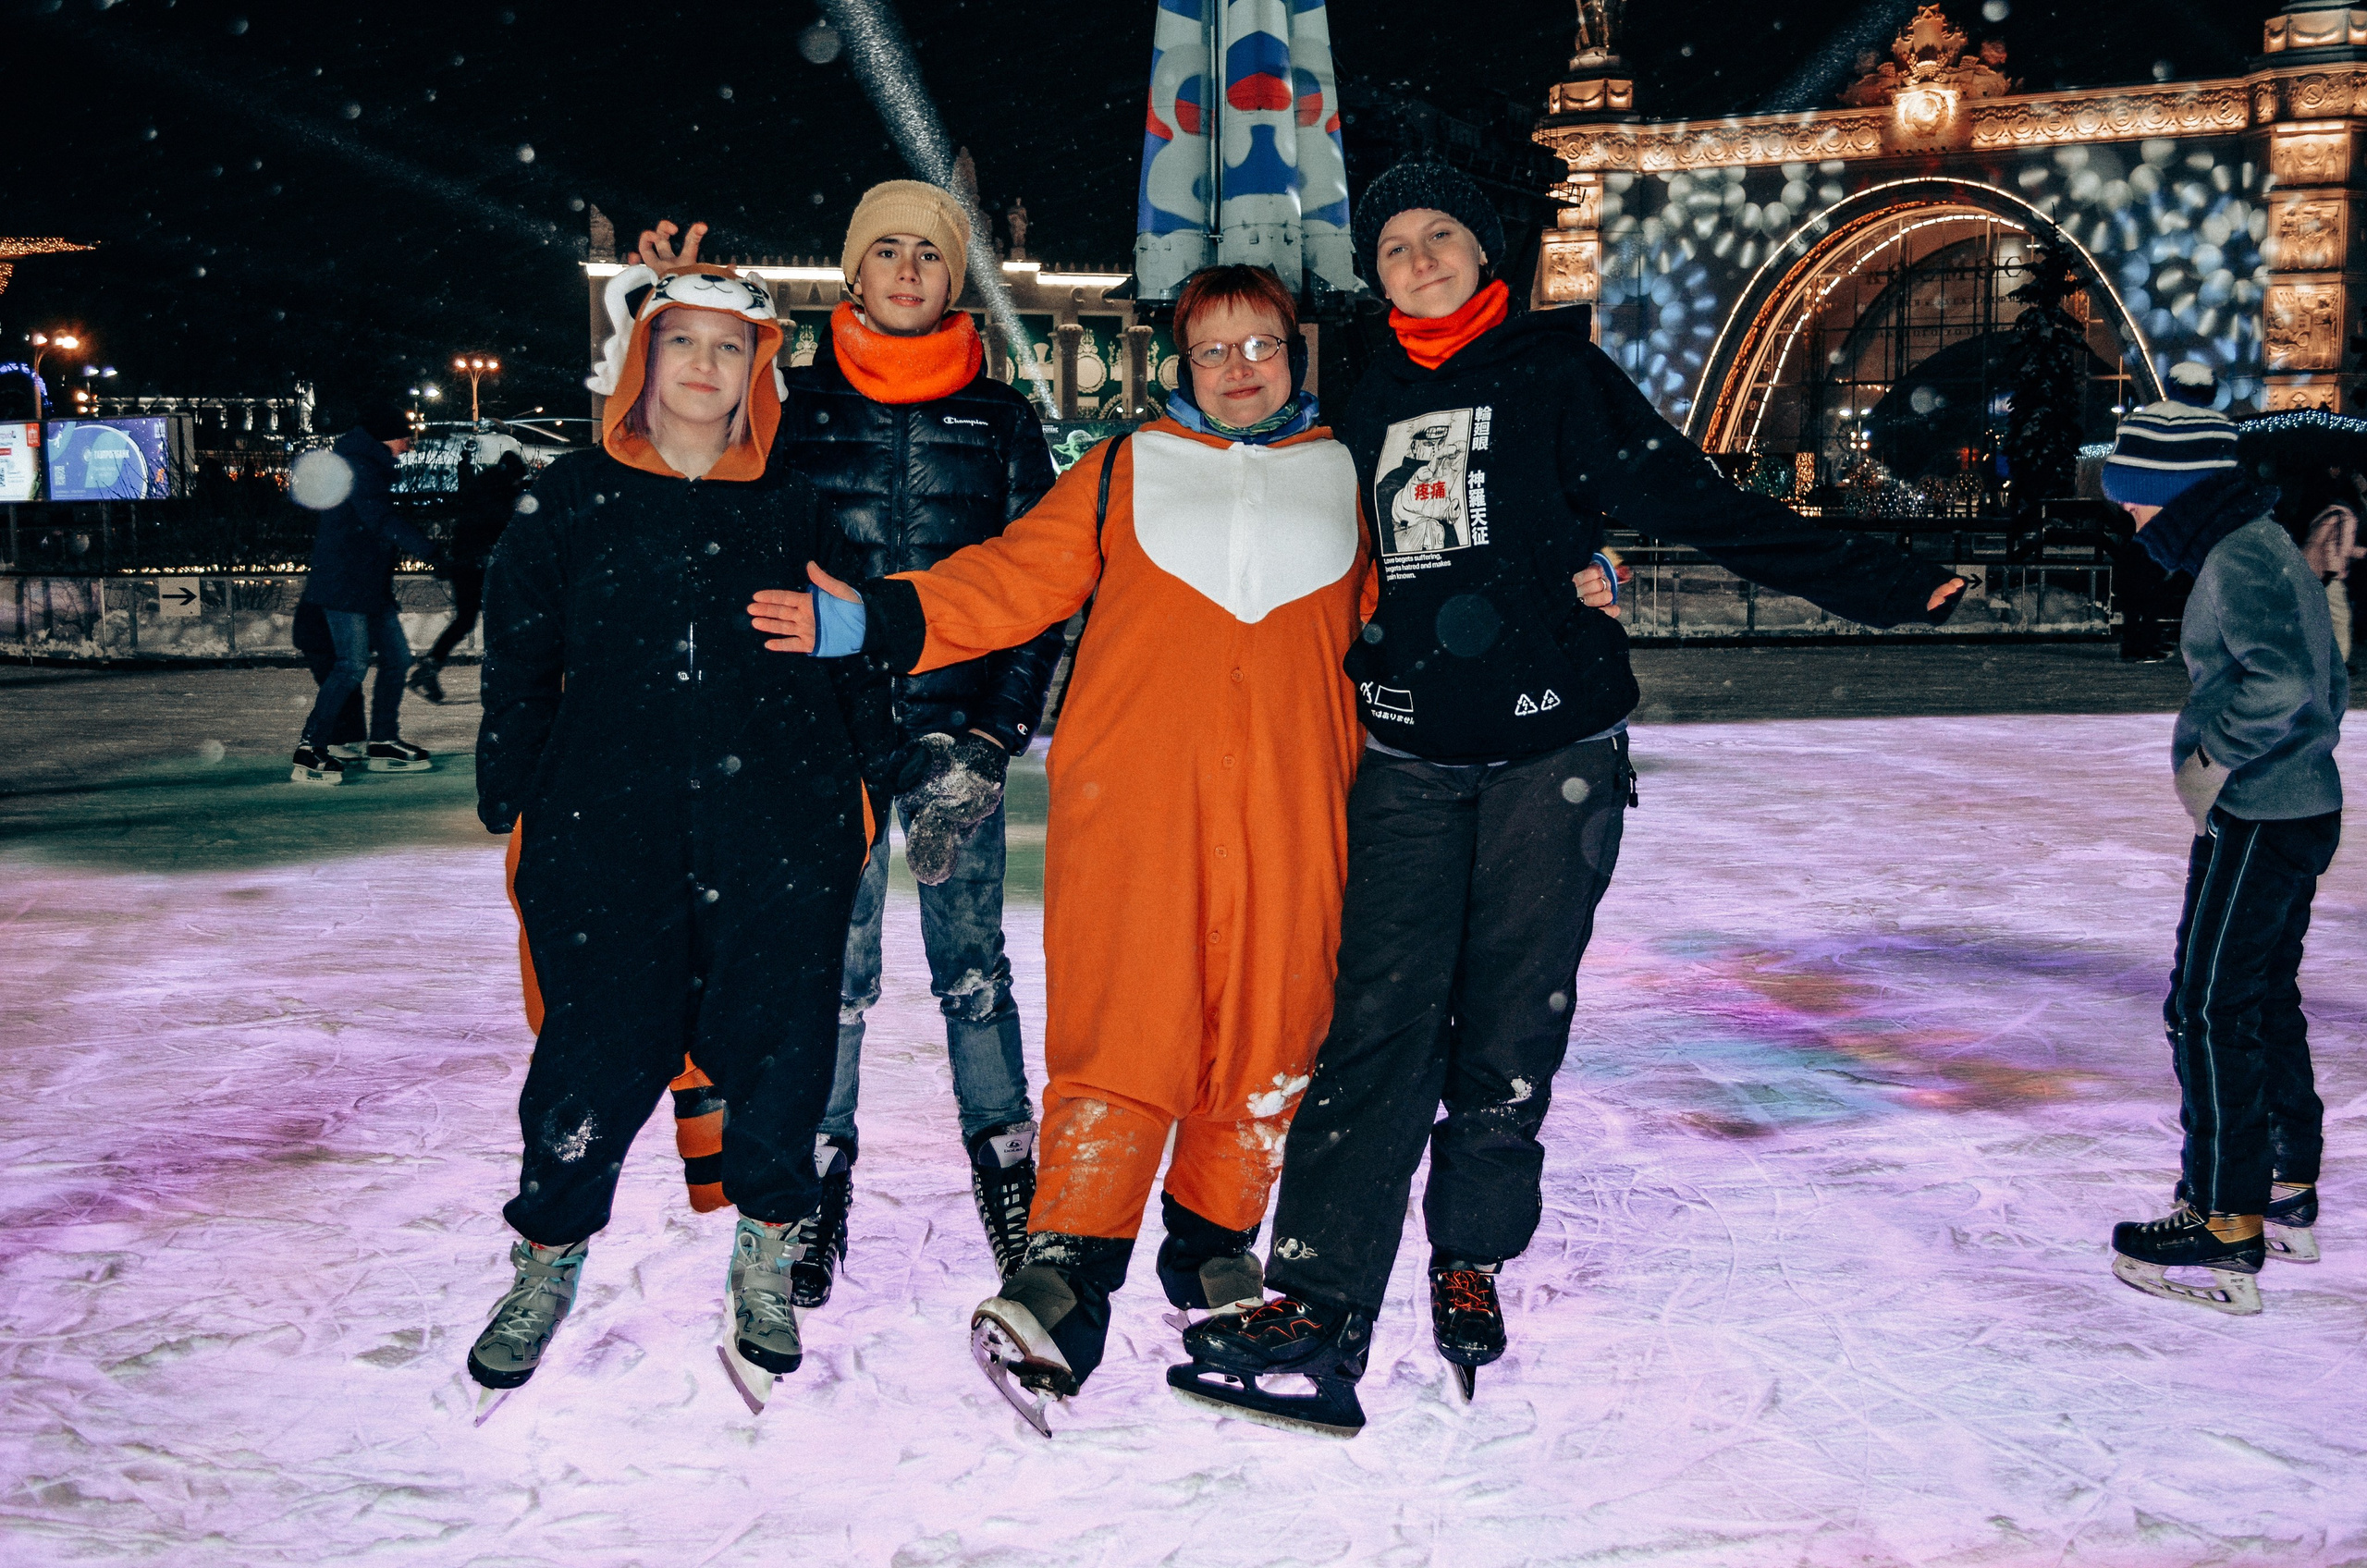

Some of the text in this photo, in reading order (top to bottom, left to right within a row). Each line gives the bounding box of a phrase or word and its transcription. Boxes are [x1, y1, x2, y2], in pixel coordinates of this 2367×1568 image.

[943, 416, 989, 426] Champion
[1415, 481, 1446, 500] 疼痛
[1467, 470, 1490, 545] 神羅天征
[1394, 556, 1414, 564] begets
[1414, 553, 1442, 562] suffering,
[1385, 565, 1402, 573] begets
[1420, 561, 1432, 570] and
[1432, 559, 1452, 569] makes
